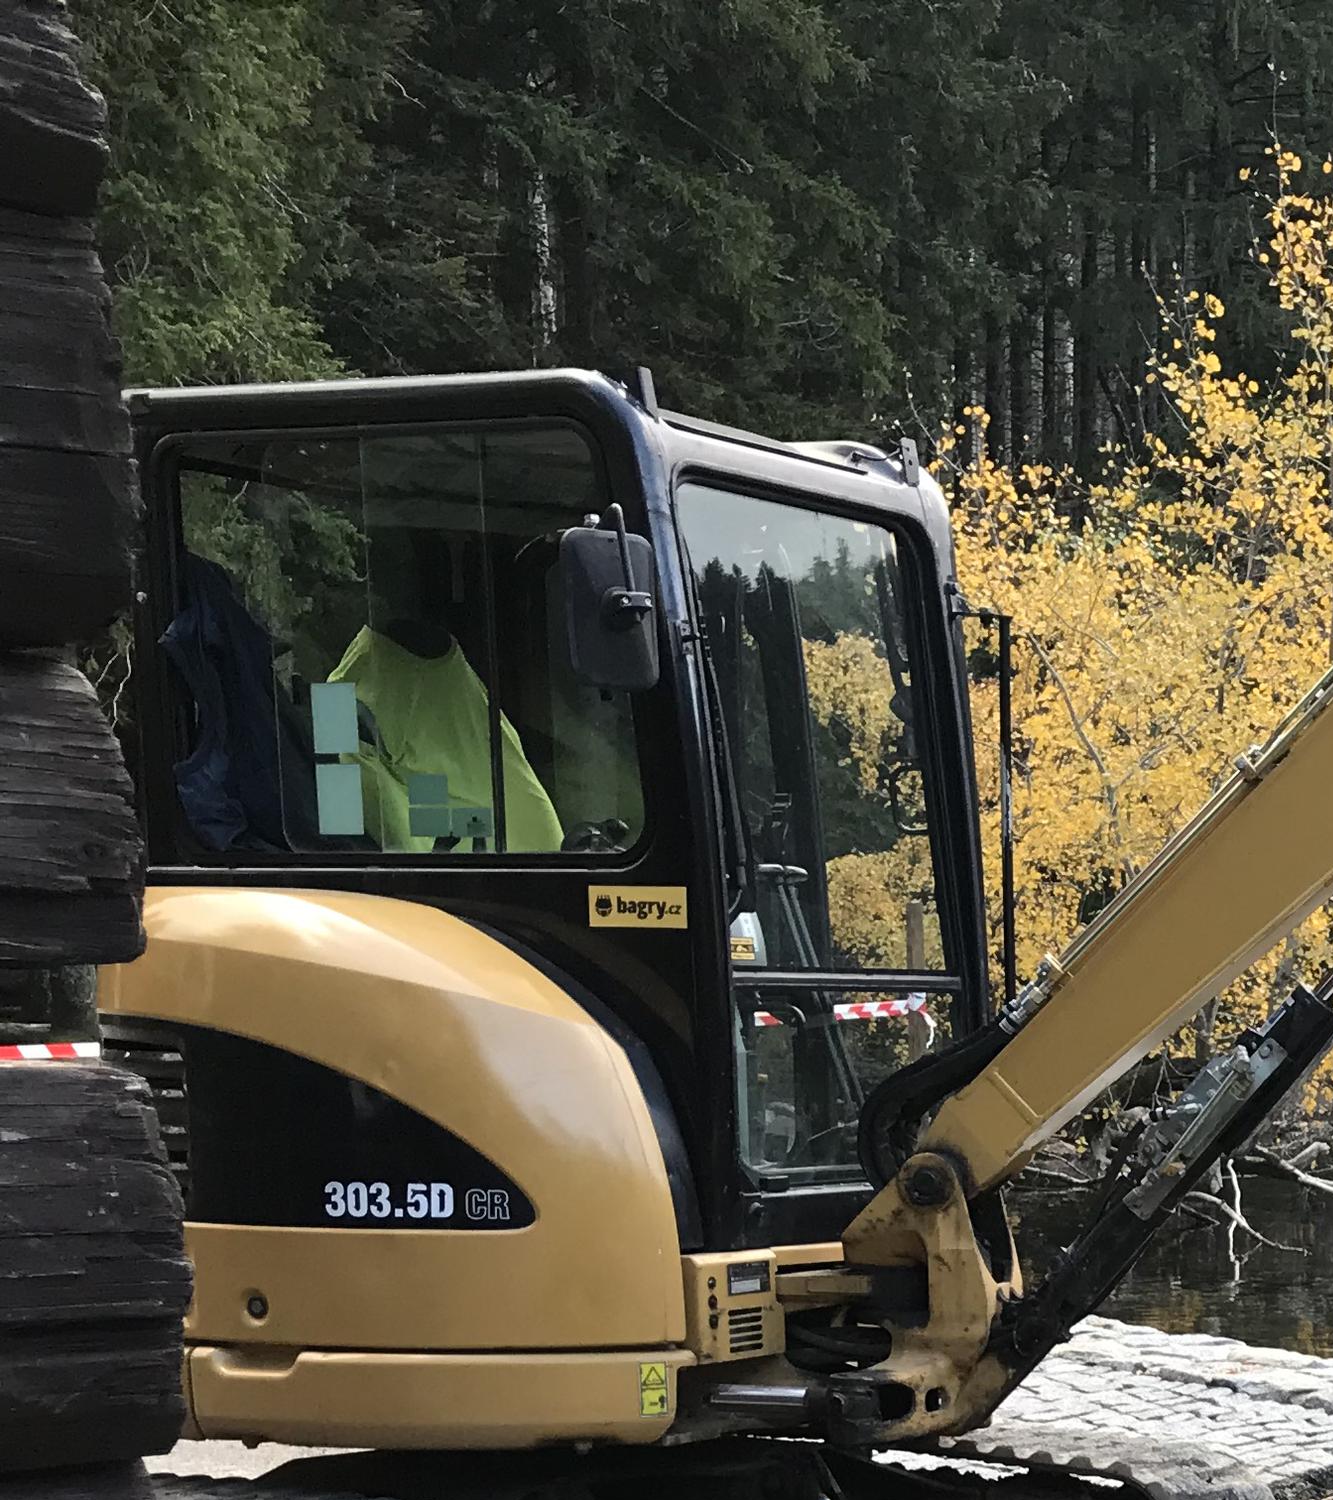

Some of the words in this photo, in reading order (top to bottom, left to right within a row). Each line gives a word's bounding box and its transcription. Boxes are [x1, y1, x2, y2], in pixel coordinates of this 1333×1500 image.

[616, 896, 682, 919] bagry.cz
[324, 1181, 454, 1218] 303.5D
[465, 1188, 510, 1220] CR
